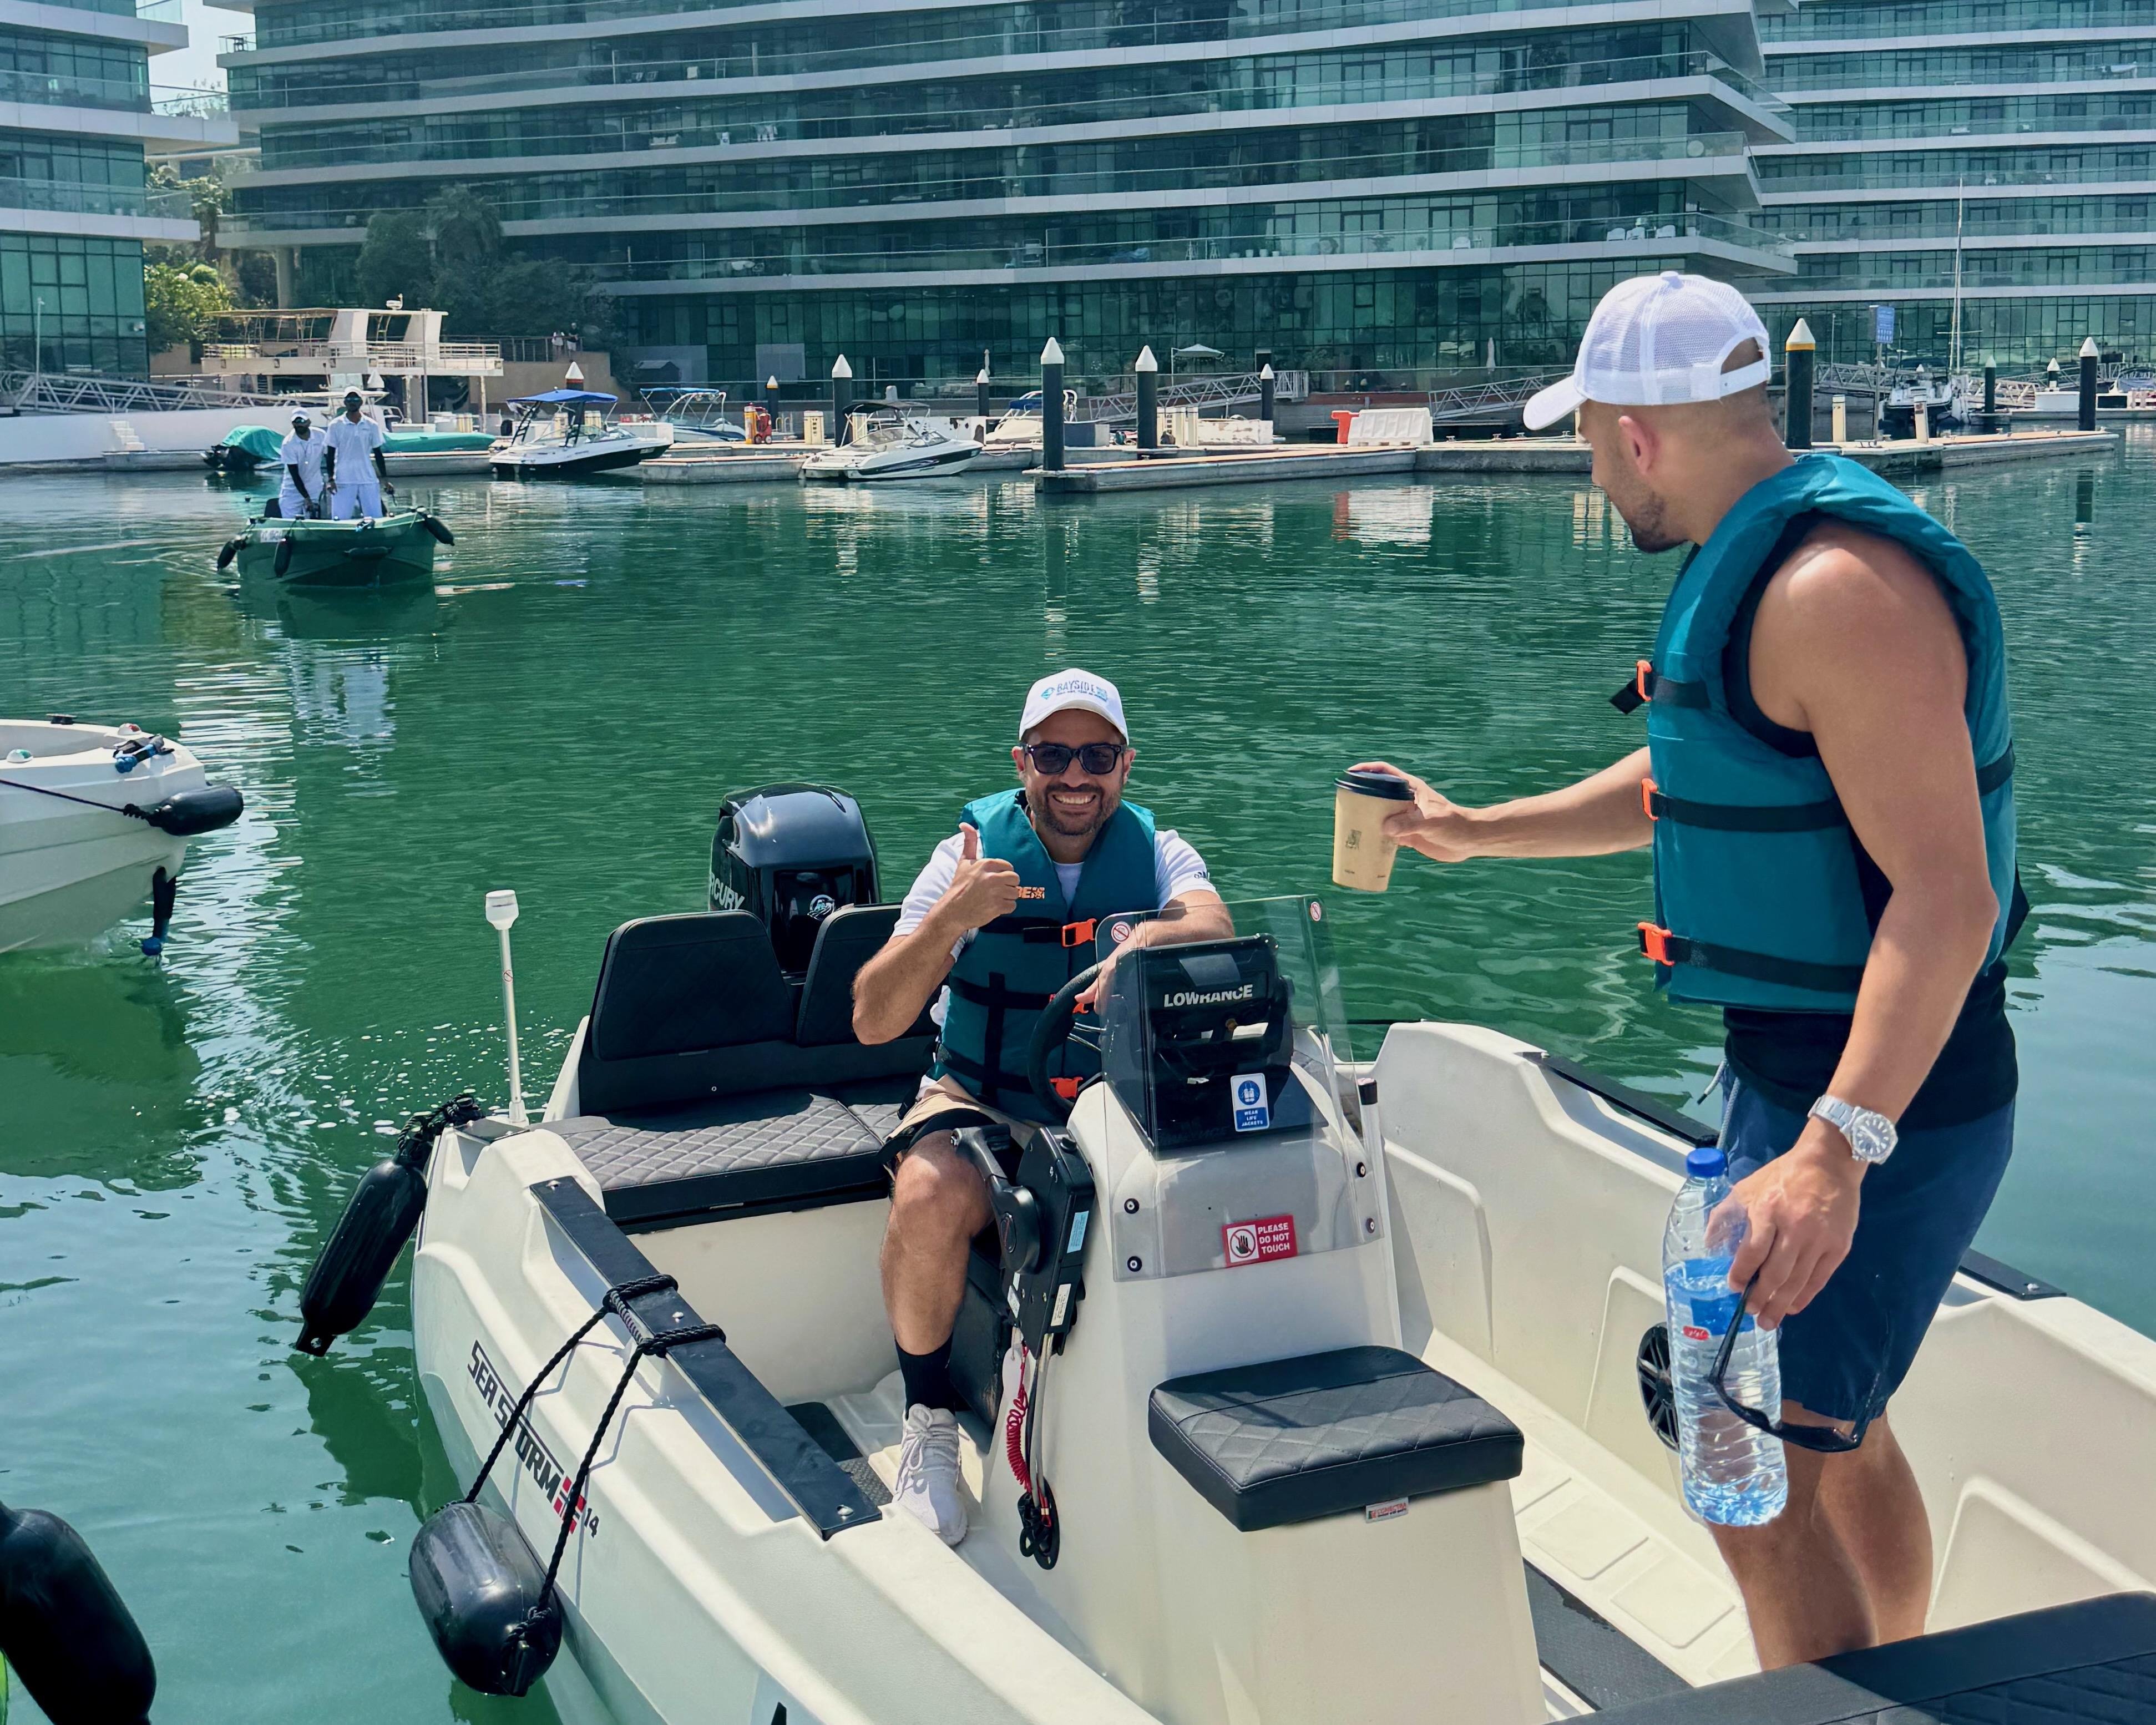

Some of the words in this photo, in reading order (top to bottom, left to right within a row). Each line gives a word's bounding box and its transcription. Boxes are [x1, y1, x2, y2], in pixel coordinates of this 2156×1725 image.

[1057, 680, 1095, 693] BAYSIDE
[1163, 984, 1253, 1008] LOWRANCE
[1258, 1222, 1289, 1234] PLEASE
[1273, 1232, 1289, 1242] NOT
[1261, 1243, 1290, 1254] TOUCH
[467, 1339, 498, 1409] SEA
